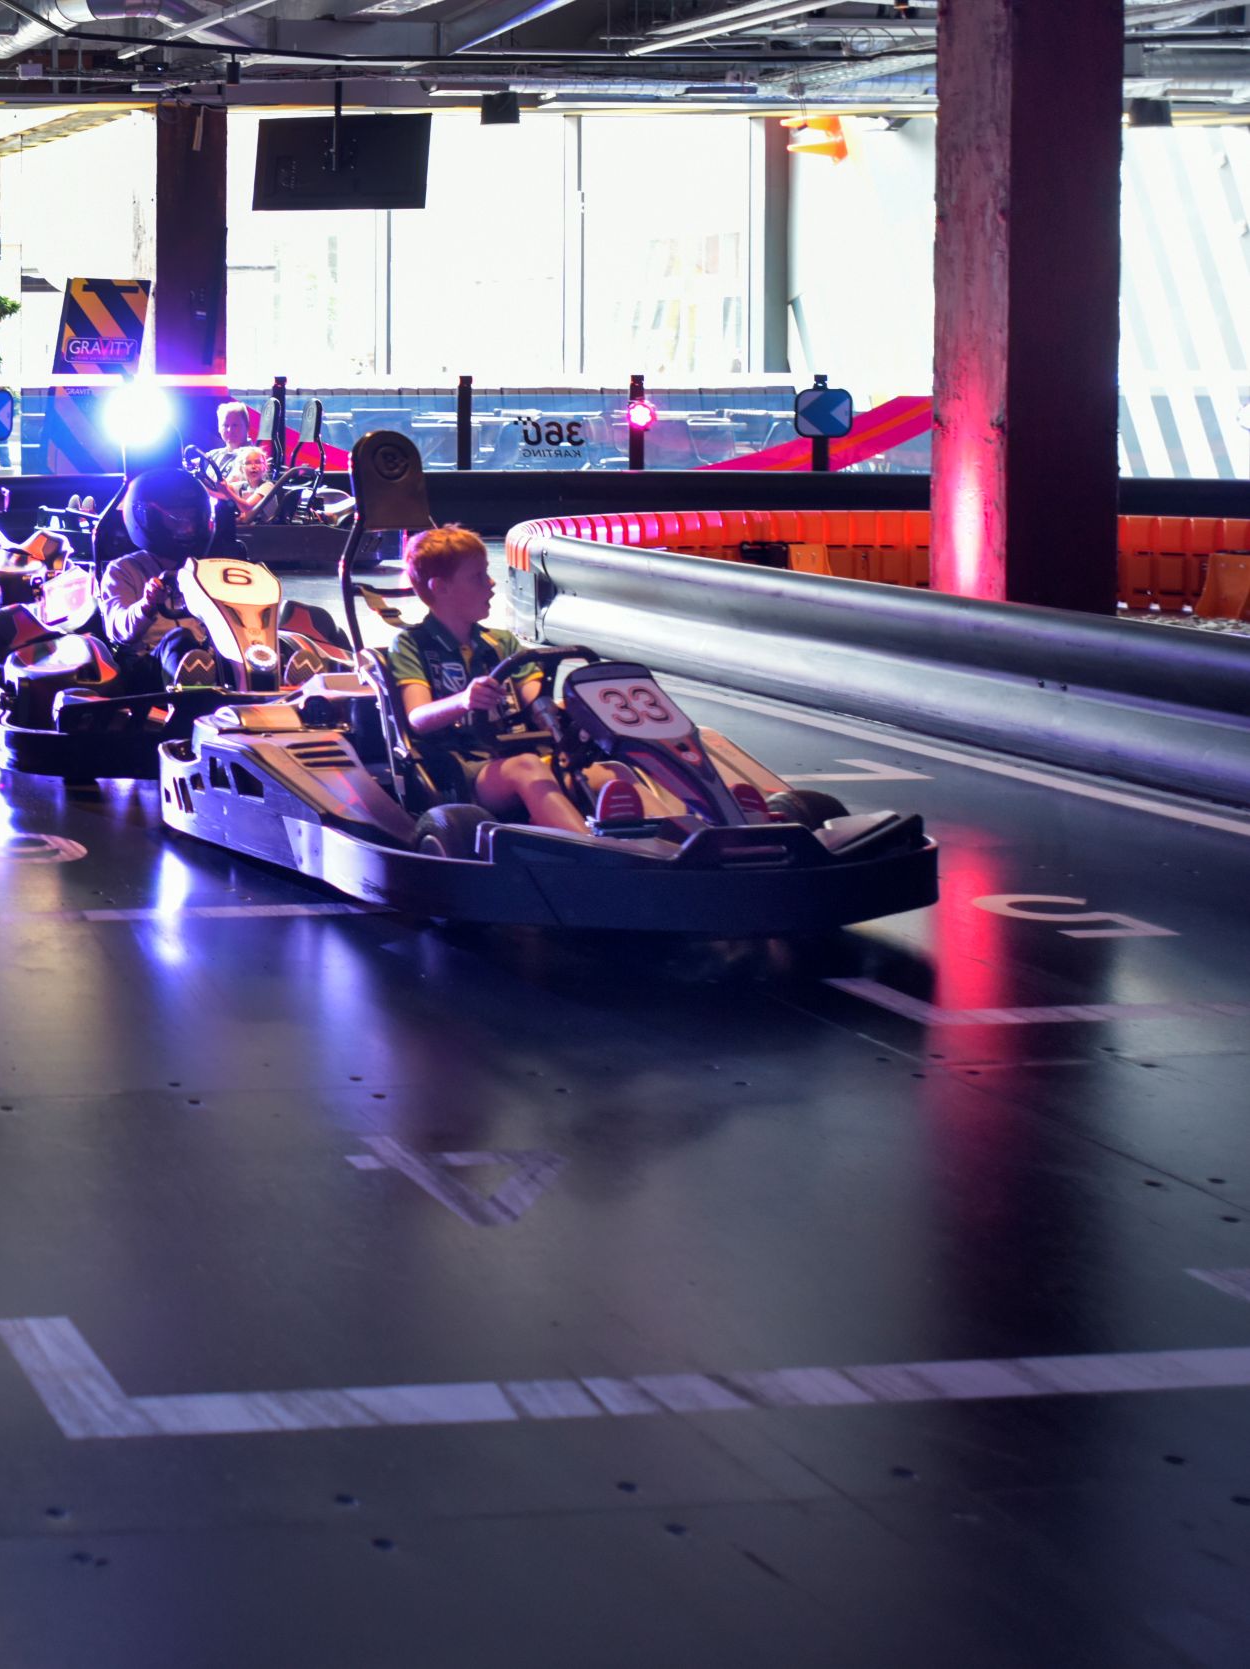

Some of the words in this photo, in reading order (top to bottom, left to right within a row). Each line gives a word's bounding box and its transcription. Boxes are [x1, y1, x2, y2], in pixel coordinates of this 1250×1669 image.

[68, 339, 134, 356] GRAVITY
[222, 567, 252, 585] 6
[598, 685, 674, 727] 33
[344, 1135, 571, 1228] 4
